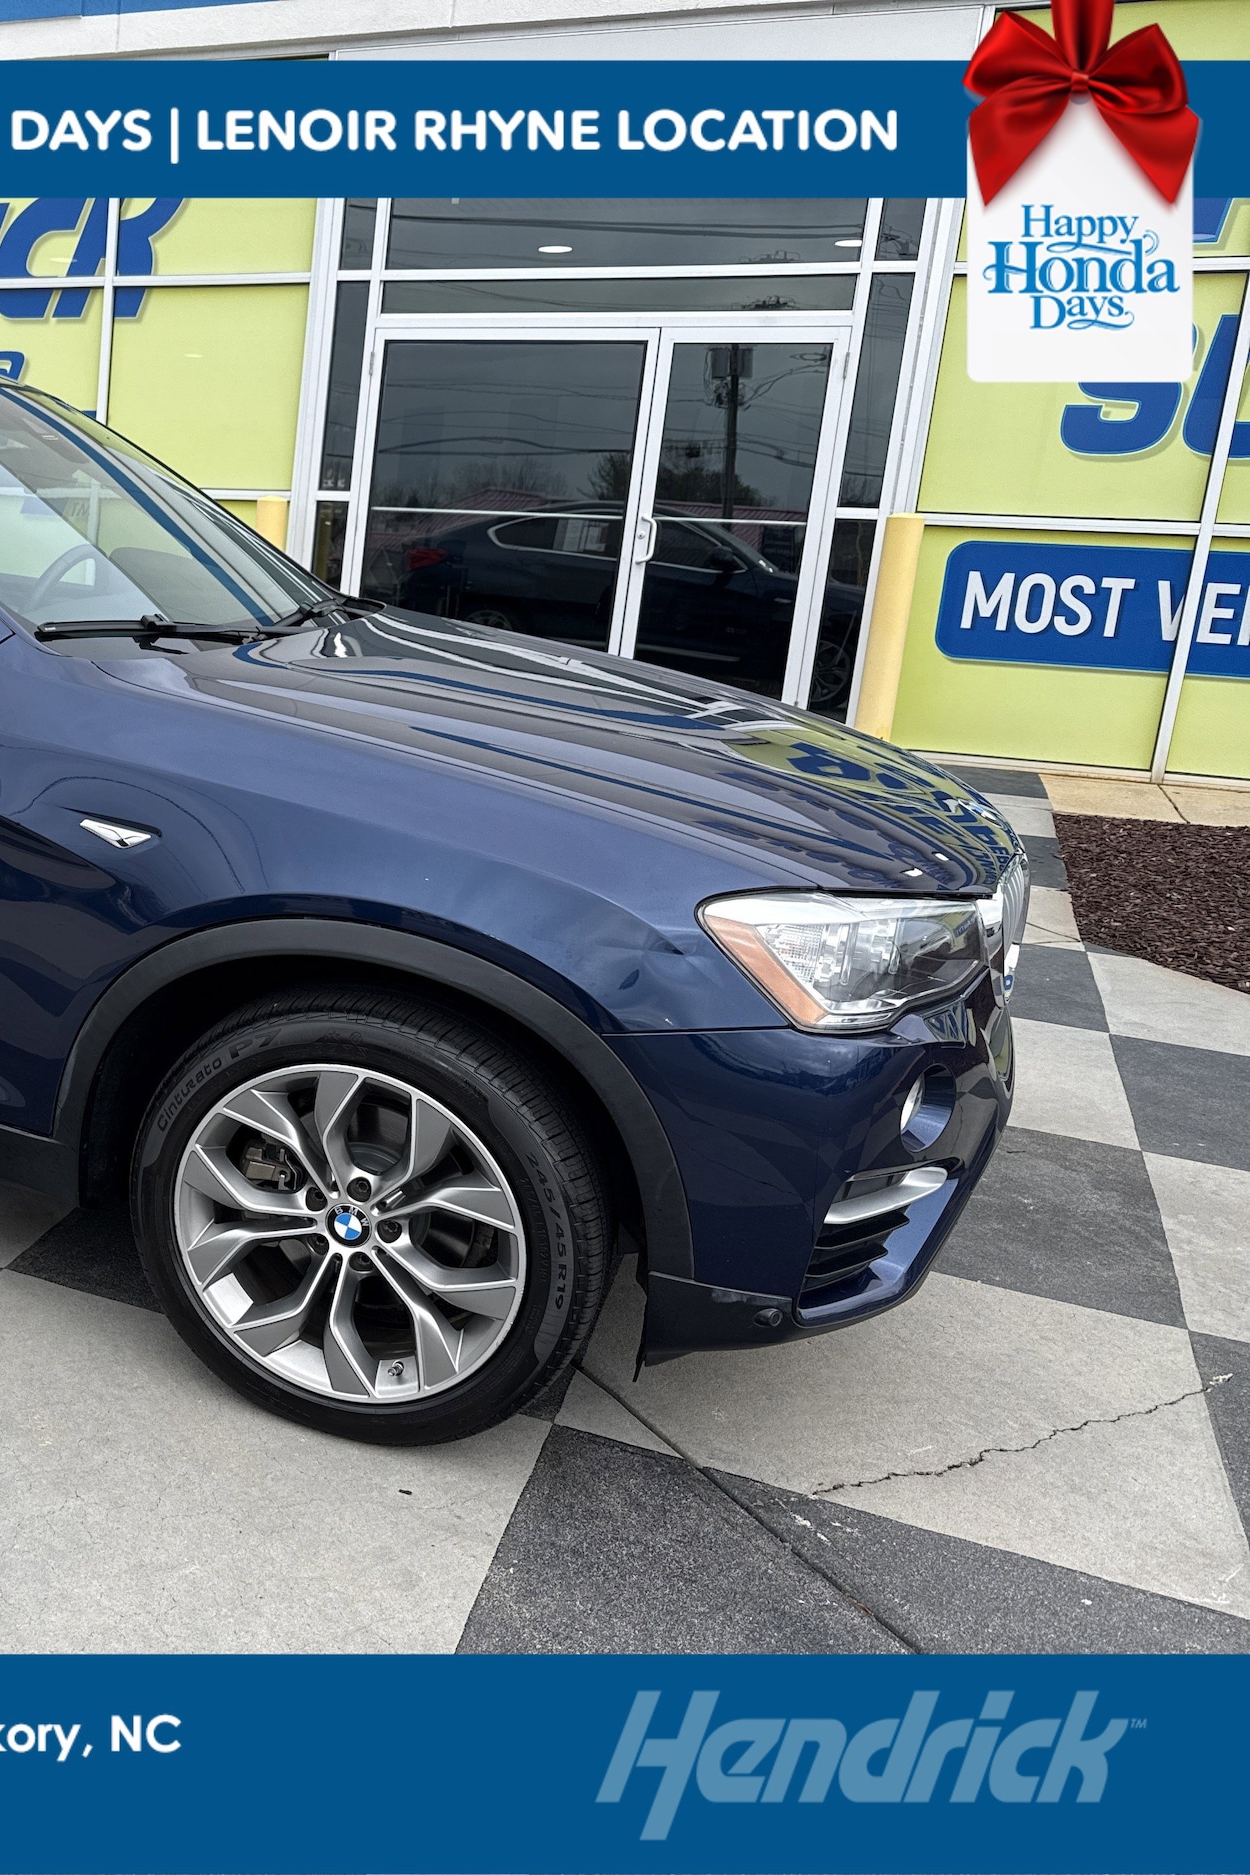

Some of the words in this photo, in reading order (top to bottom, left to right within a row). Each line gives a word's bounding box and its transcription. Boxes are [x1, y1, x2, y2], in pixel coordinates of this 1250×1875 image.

[960, 570, 1136, 639] MOST
[228, 1028, 282, 1060] P7
[334, 1206, 370, 1227] BMW
